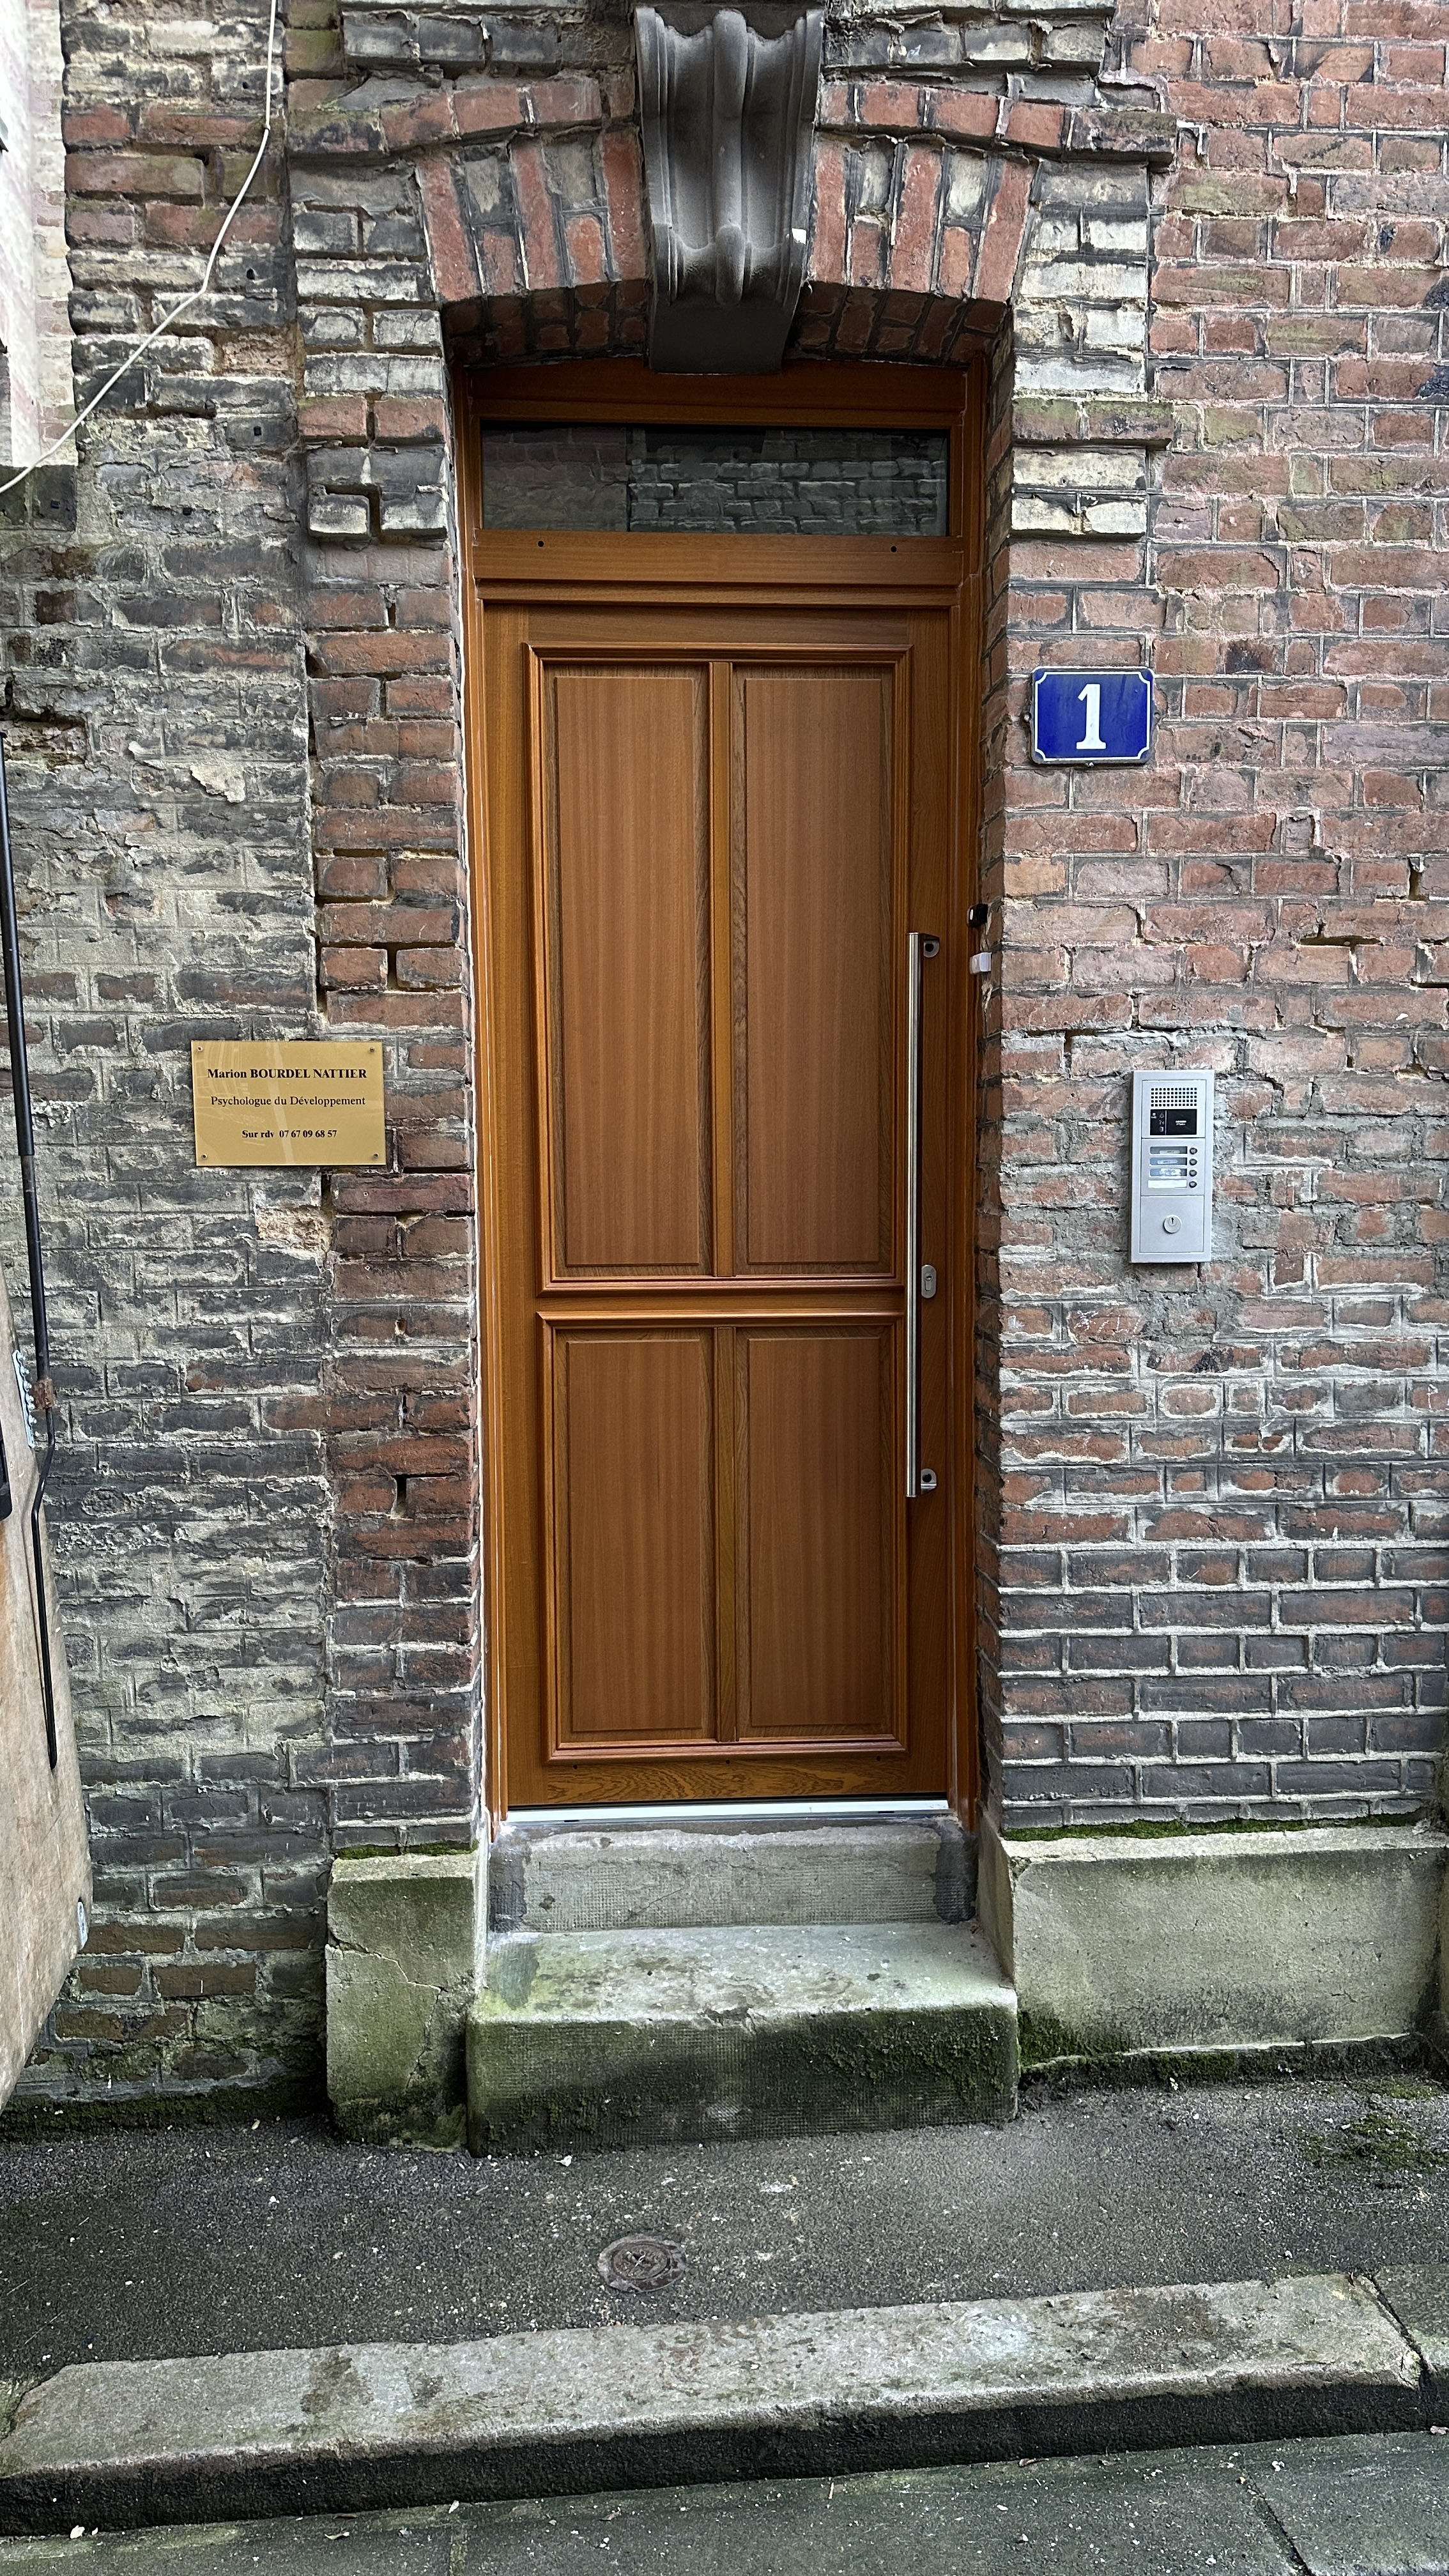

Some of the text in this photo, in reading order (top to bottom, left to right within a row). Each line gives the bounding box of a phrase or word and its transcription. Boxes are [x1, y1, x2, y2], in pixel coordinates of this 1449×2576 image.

[1077, 684, 1106, 749] 1
[208, 1068, 367, 1078] Marion BOURDEL NATTIER
[210, 1096, 366, 1108] Psychologue du Développement
[241, 1130, 337, 1138] Sur rdv 07 67 09 68 57
